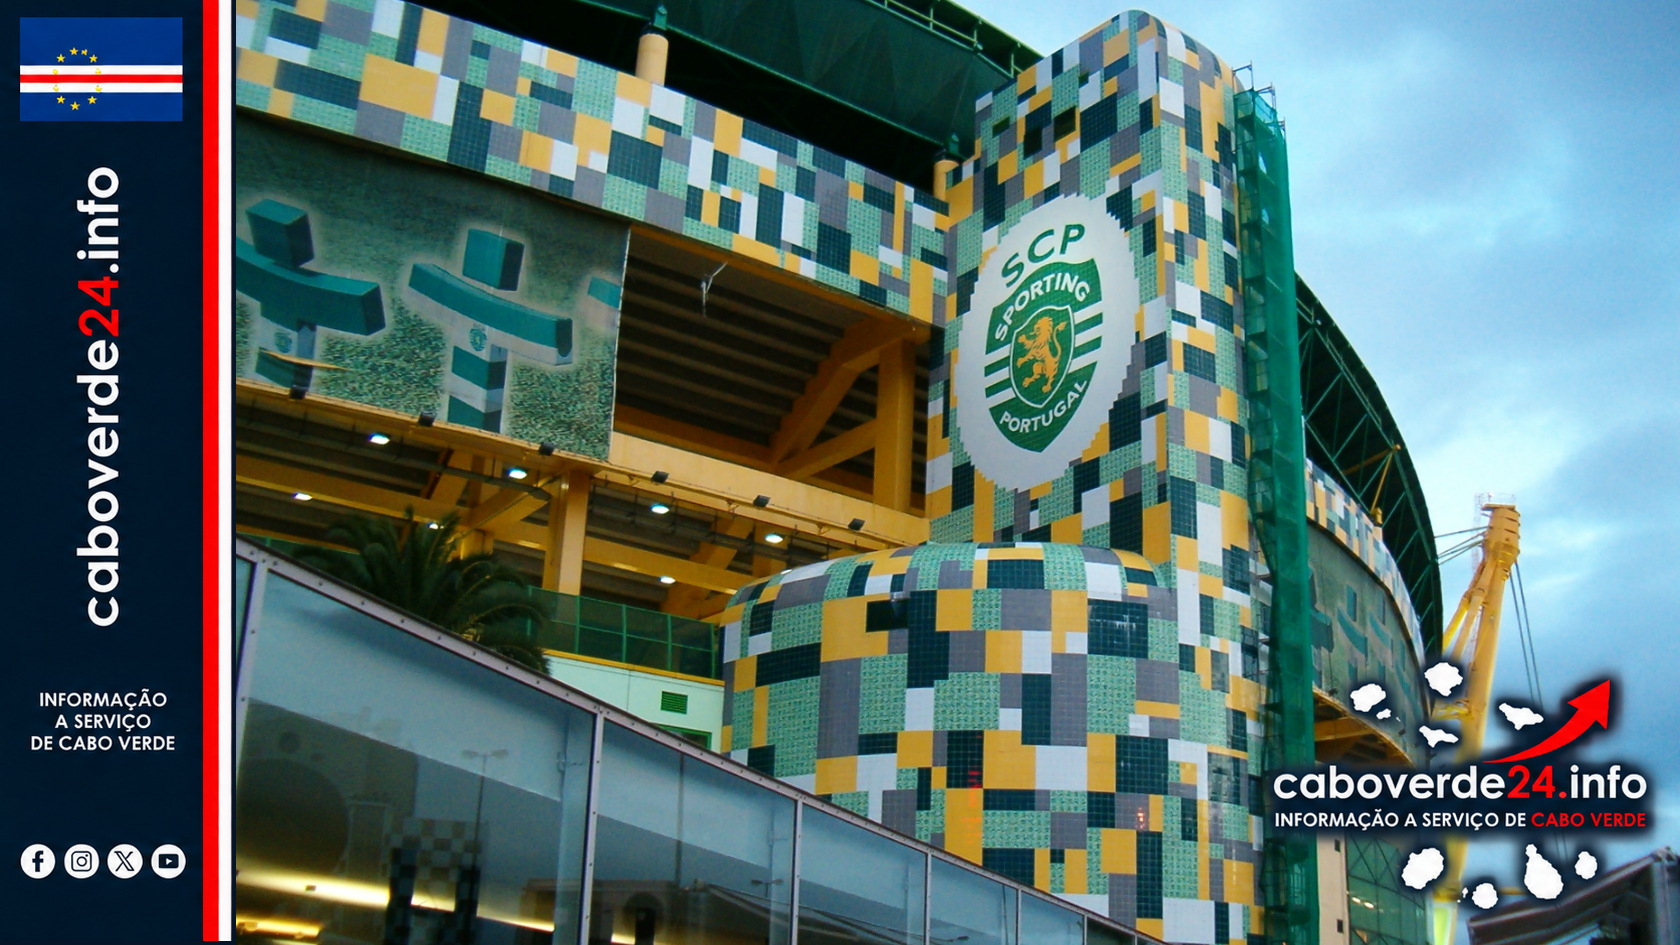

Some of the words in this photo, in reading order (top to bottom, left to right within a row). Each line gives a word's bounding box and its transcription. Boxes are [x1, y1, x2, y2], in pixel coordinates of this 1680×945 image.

[1001, 223, 1085, 287] SCP
[994, 272, 1090, 342] SPORTING
[999, 379, 1088, 434] PORTUGAL
